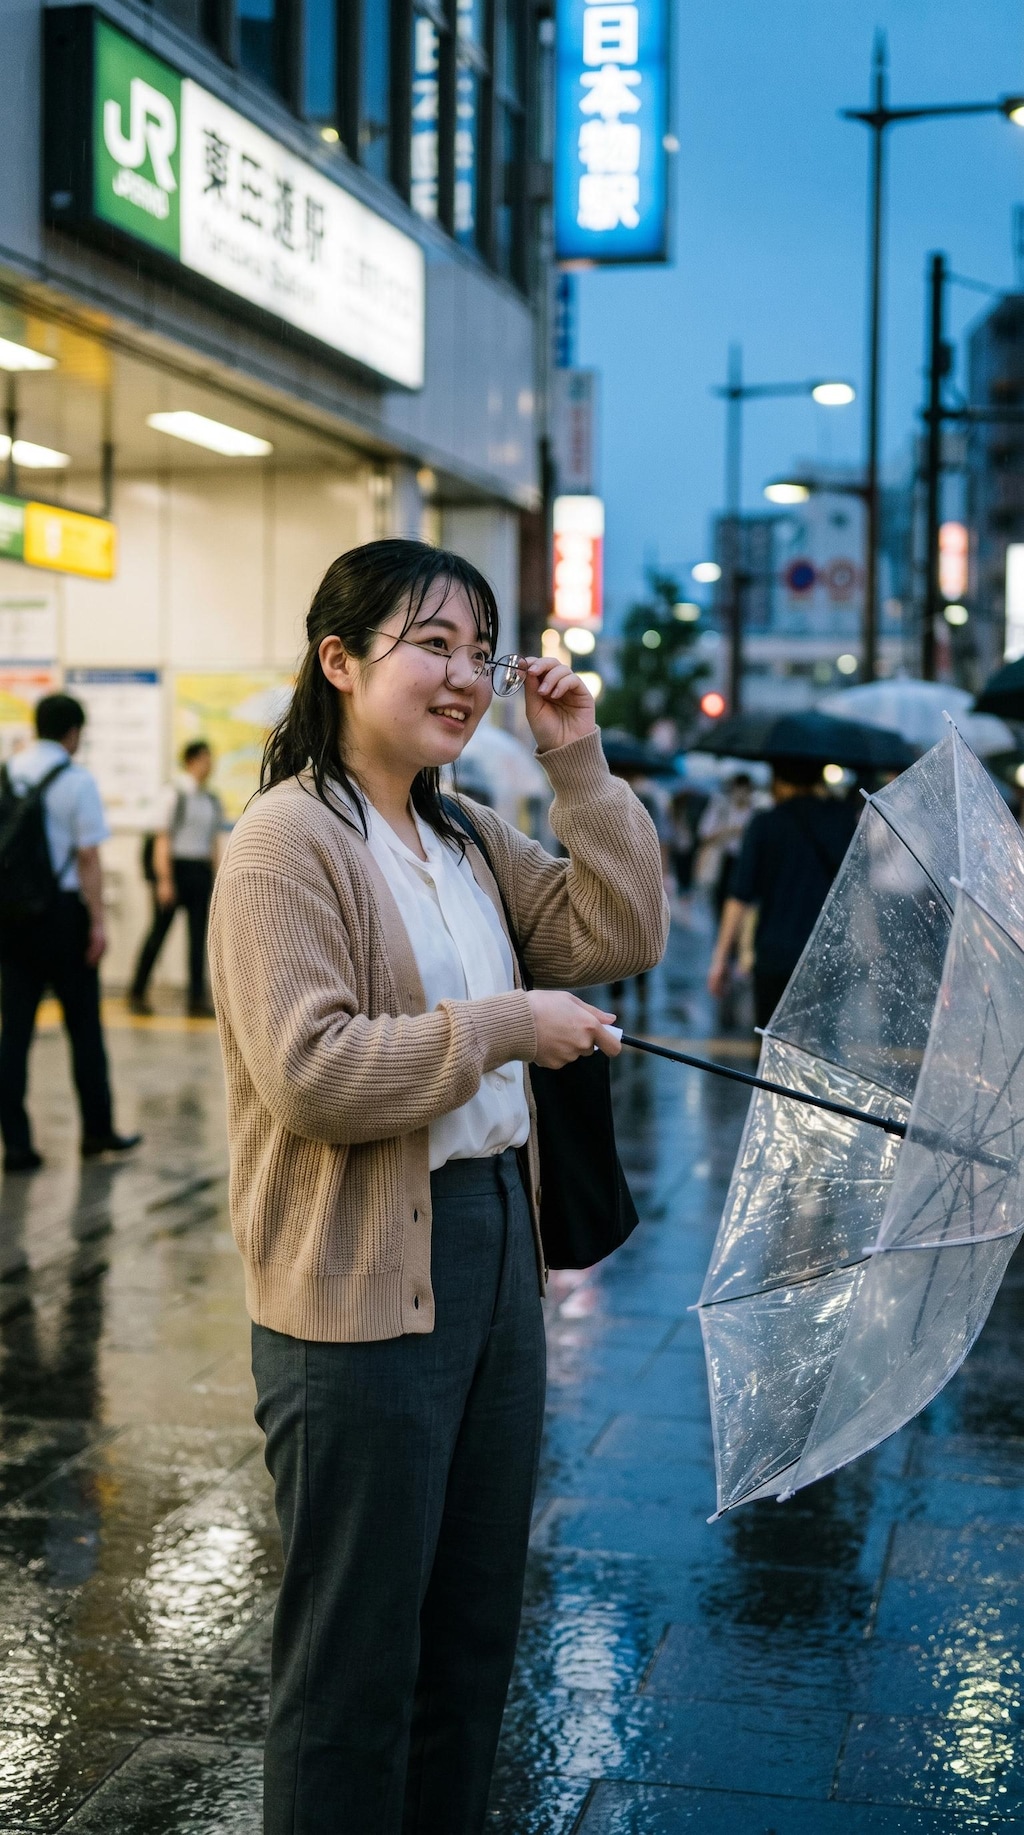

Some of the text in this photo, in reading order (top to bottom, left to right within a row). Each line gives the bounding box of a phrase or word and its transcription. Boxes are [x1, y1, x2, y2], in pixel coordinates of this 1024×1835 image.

[103, 76, 178, 194] JR
[577, 0, 642, 231] 日本駅
